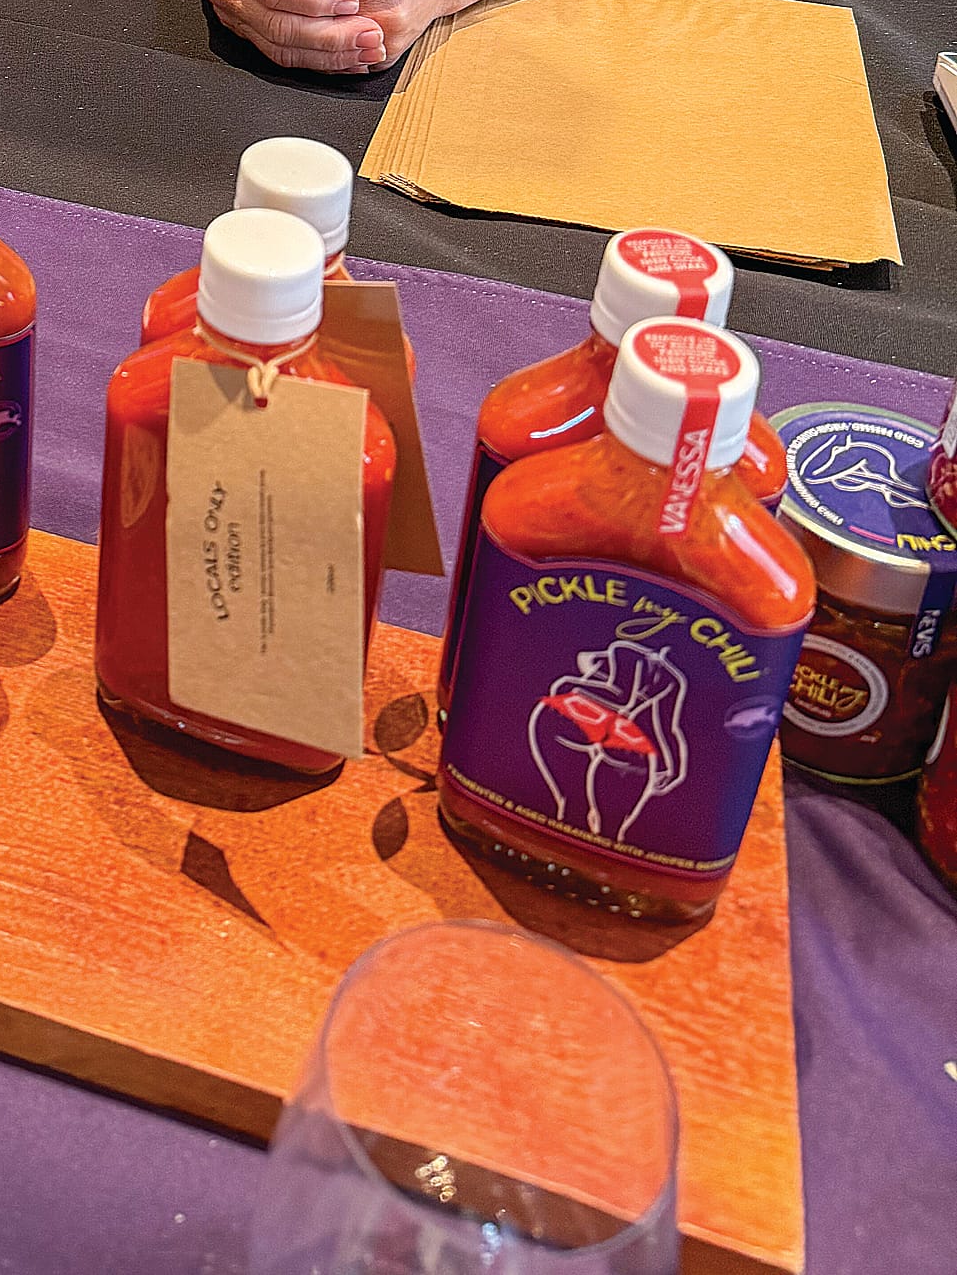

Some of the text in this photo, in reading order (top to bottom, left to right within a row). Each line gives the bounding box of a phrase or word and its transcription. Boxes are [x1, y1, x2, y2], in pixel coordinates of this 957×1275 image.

[659, 428, 709, 533] VANESSA
[202, 539, 230, 620] LOCALS
[509, 575, 628, 615] PICKLE
